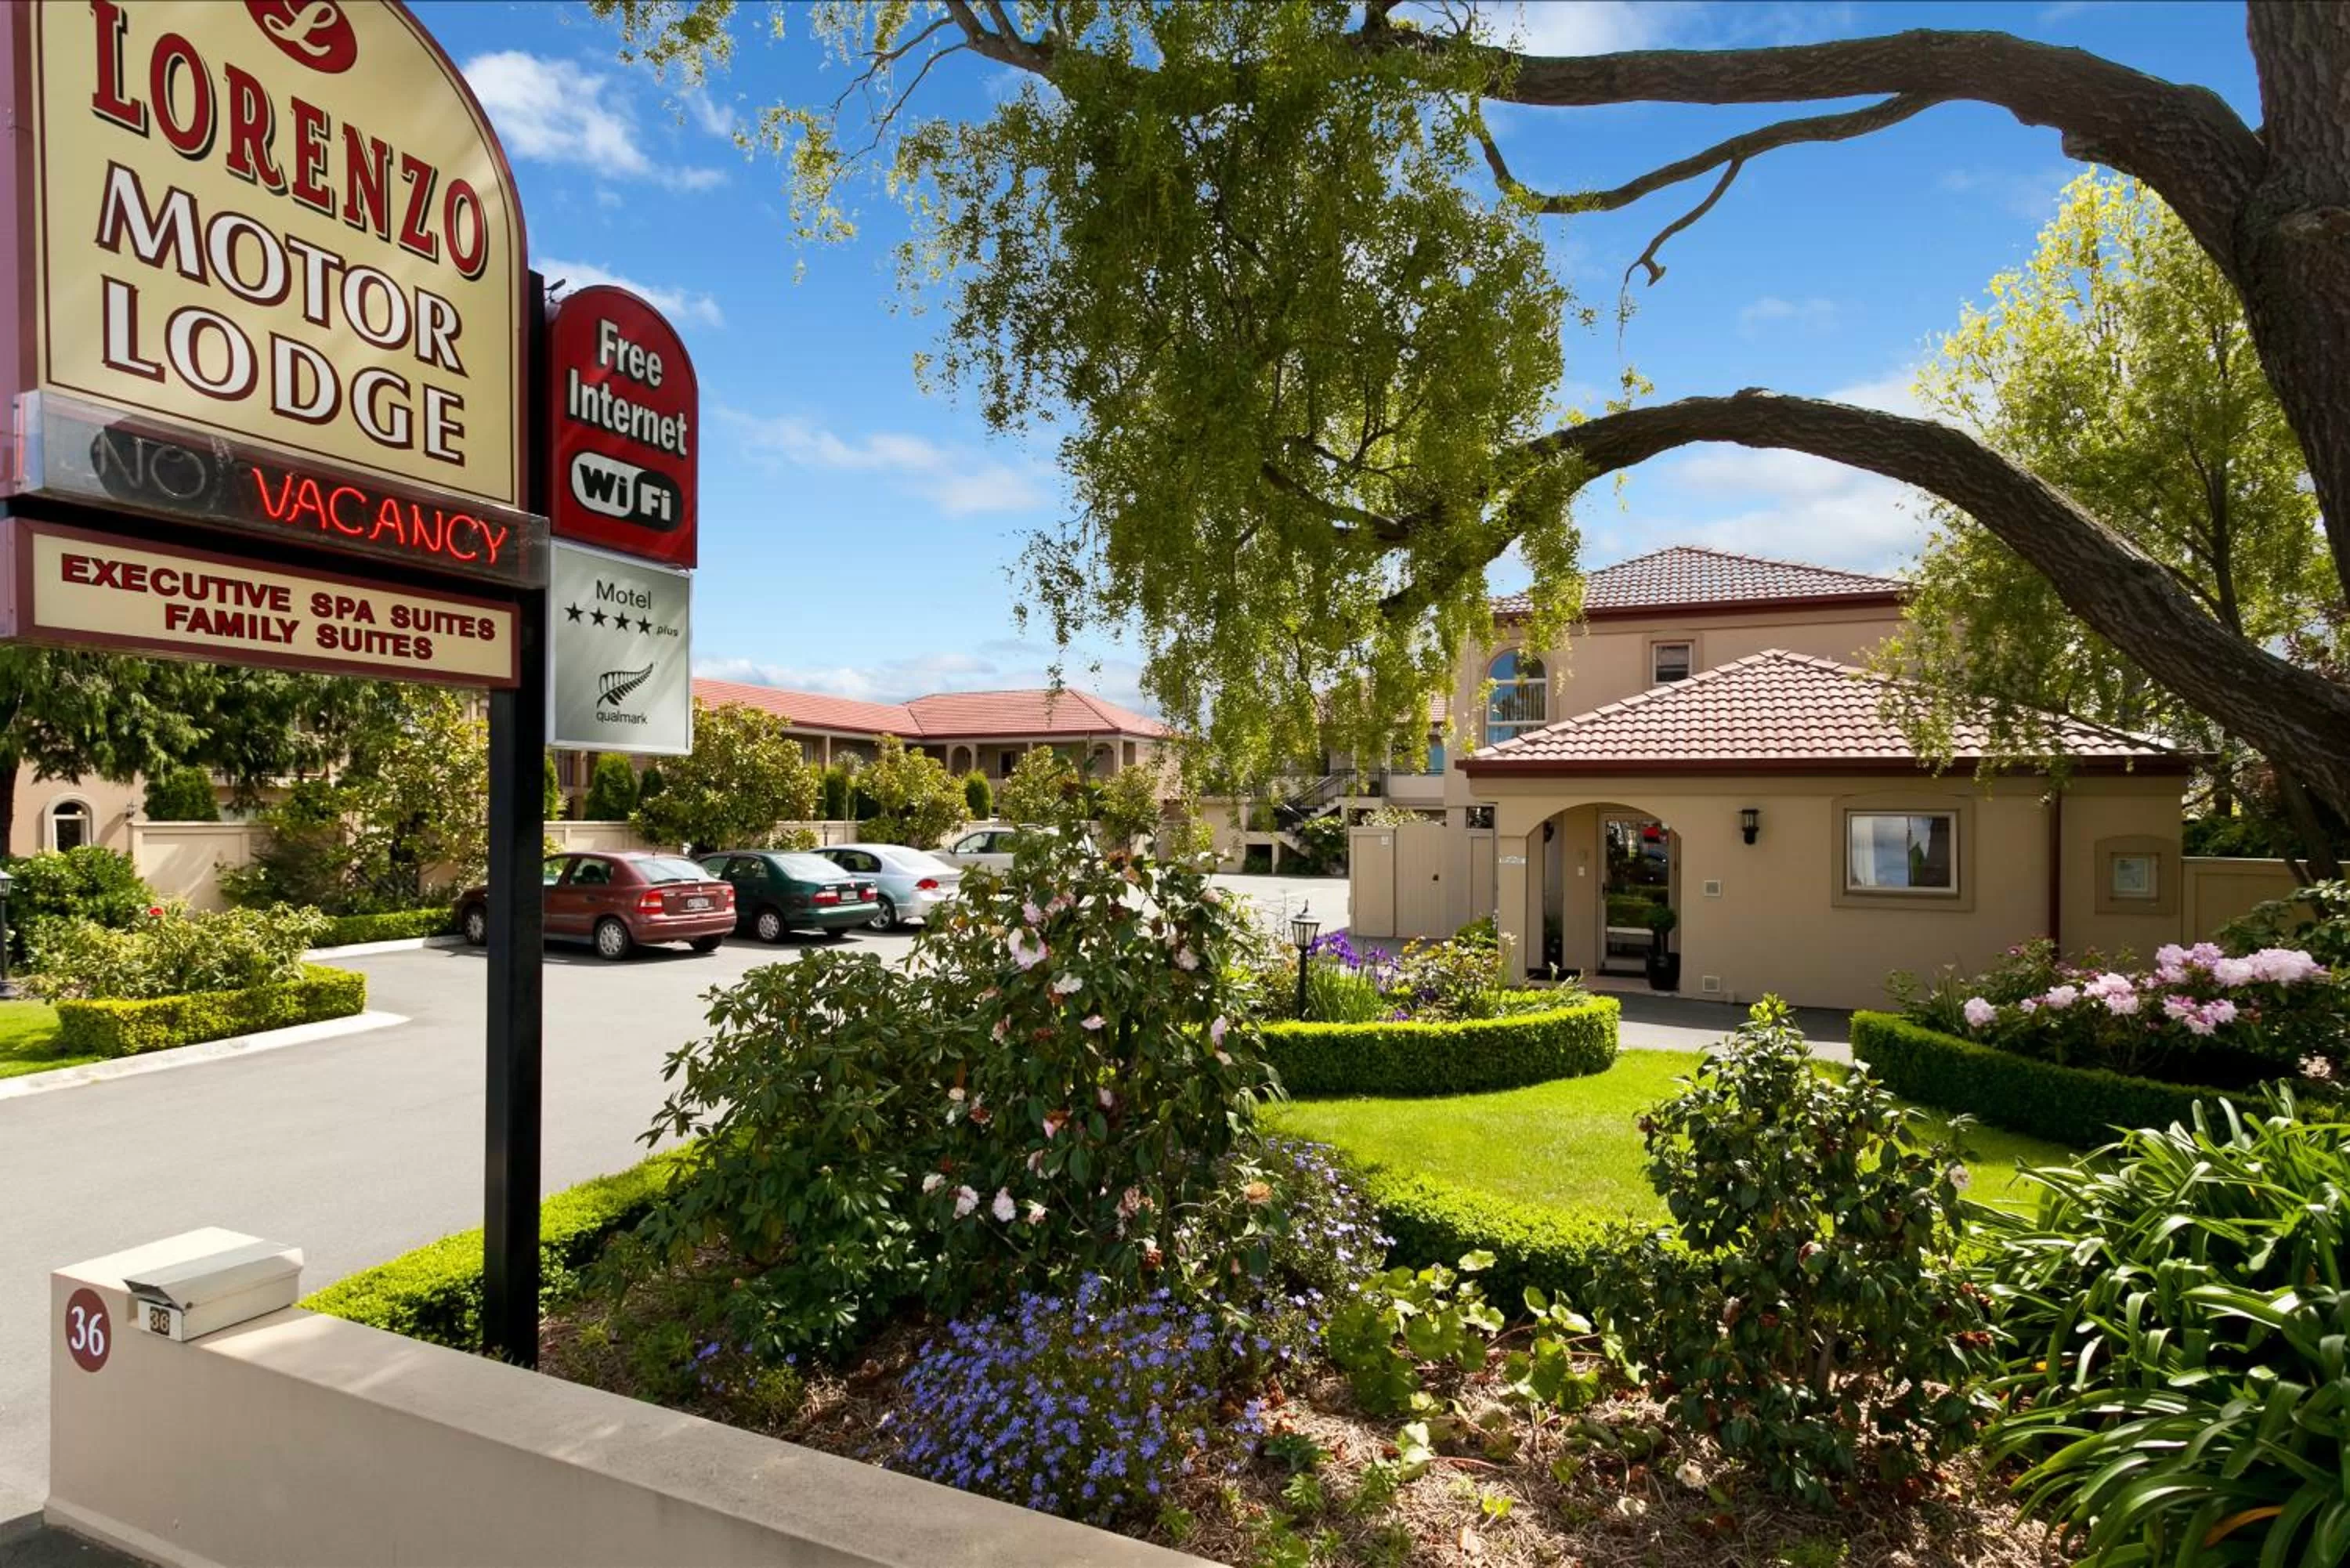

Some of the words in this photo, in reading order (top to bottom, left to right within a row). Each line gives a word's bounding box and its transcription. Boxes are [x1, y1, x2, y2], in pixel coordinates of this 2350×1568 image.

[91, 0, 488, 280] LORENZO
[95, 159, 468, 378] MOTOR
[101, 274, 465, 467] LODGE
[598, 318, 663, 387] Free
[568, 368, 687, 456] Internet
[99, 428, 206, 500] NO
[251, 468, 508, 564] VACANCY
[61, 553, 291, 612] EXECUTIVE
[310, 592, 375, 624] SPA
[390, 604, 496, 641] SUITES
[164, 603, 299, 644] FAMILY
[316, 623, 433, 660] SUITES
[596, 579, 652, 609] Motel
[656, 625, 678, 637] plus
[596, 710, 648, 724] qualmark
[70, 1306, 105, 1357] 36
